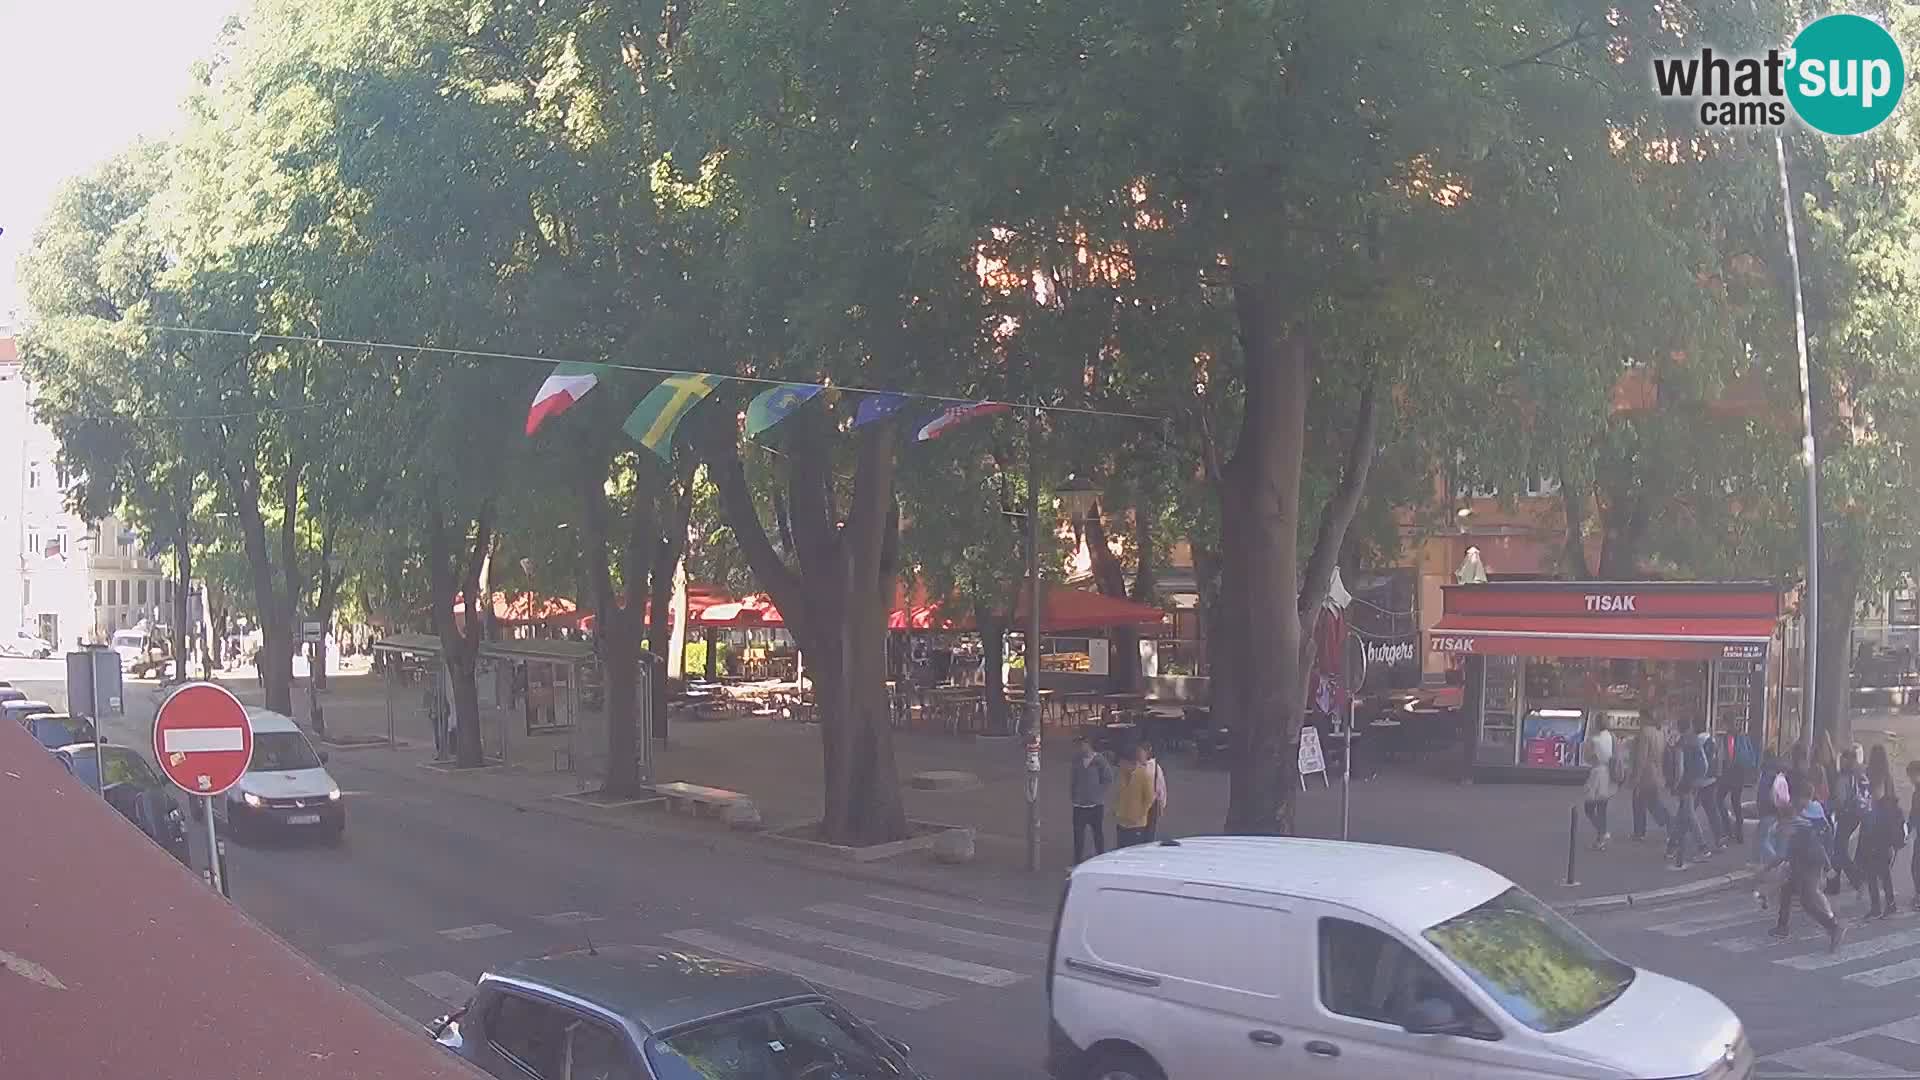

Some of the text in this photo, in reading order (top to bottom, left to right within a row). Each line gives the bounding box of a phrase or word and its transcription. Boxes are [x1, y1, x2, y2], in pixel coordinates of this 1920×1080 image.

[1584, 595, 1636, 611] TISAK
[1431, 637, 1474, 652] TISAK
[1367, 641, 1414, 667] burgers
